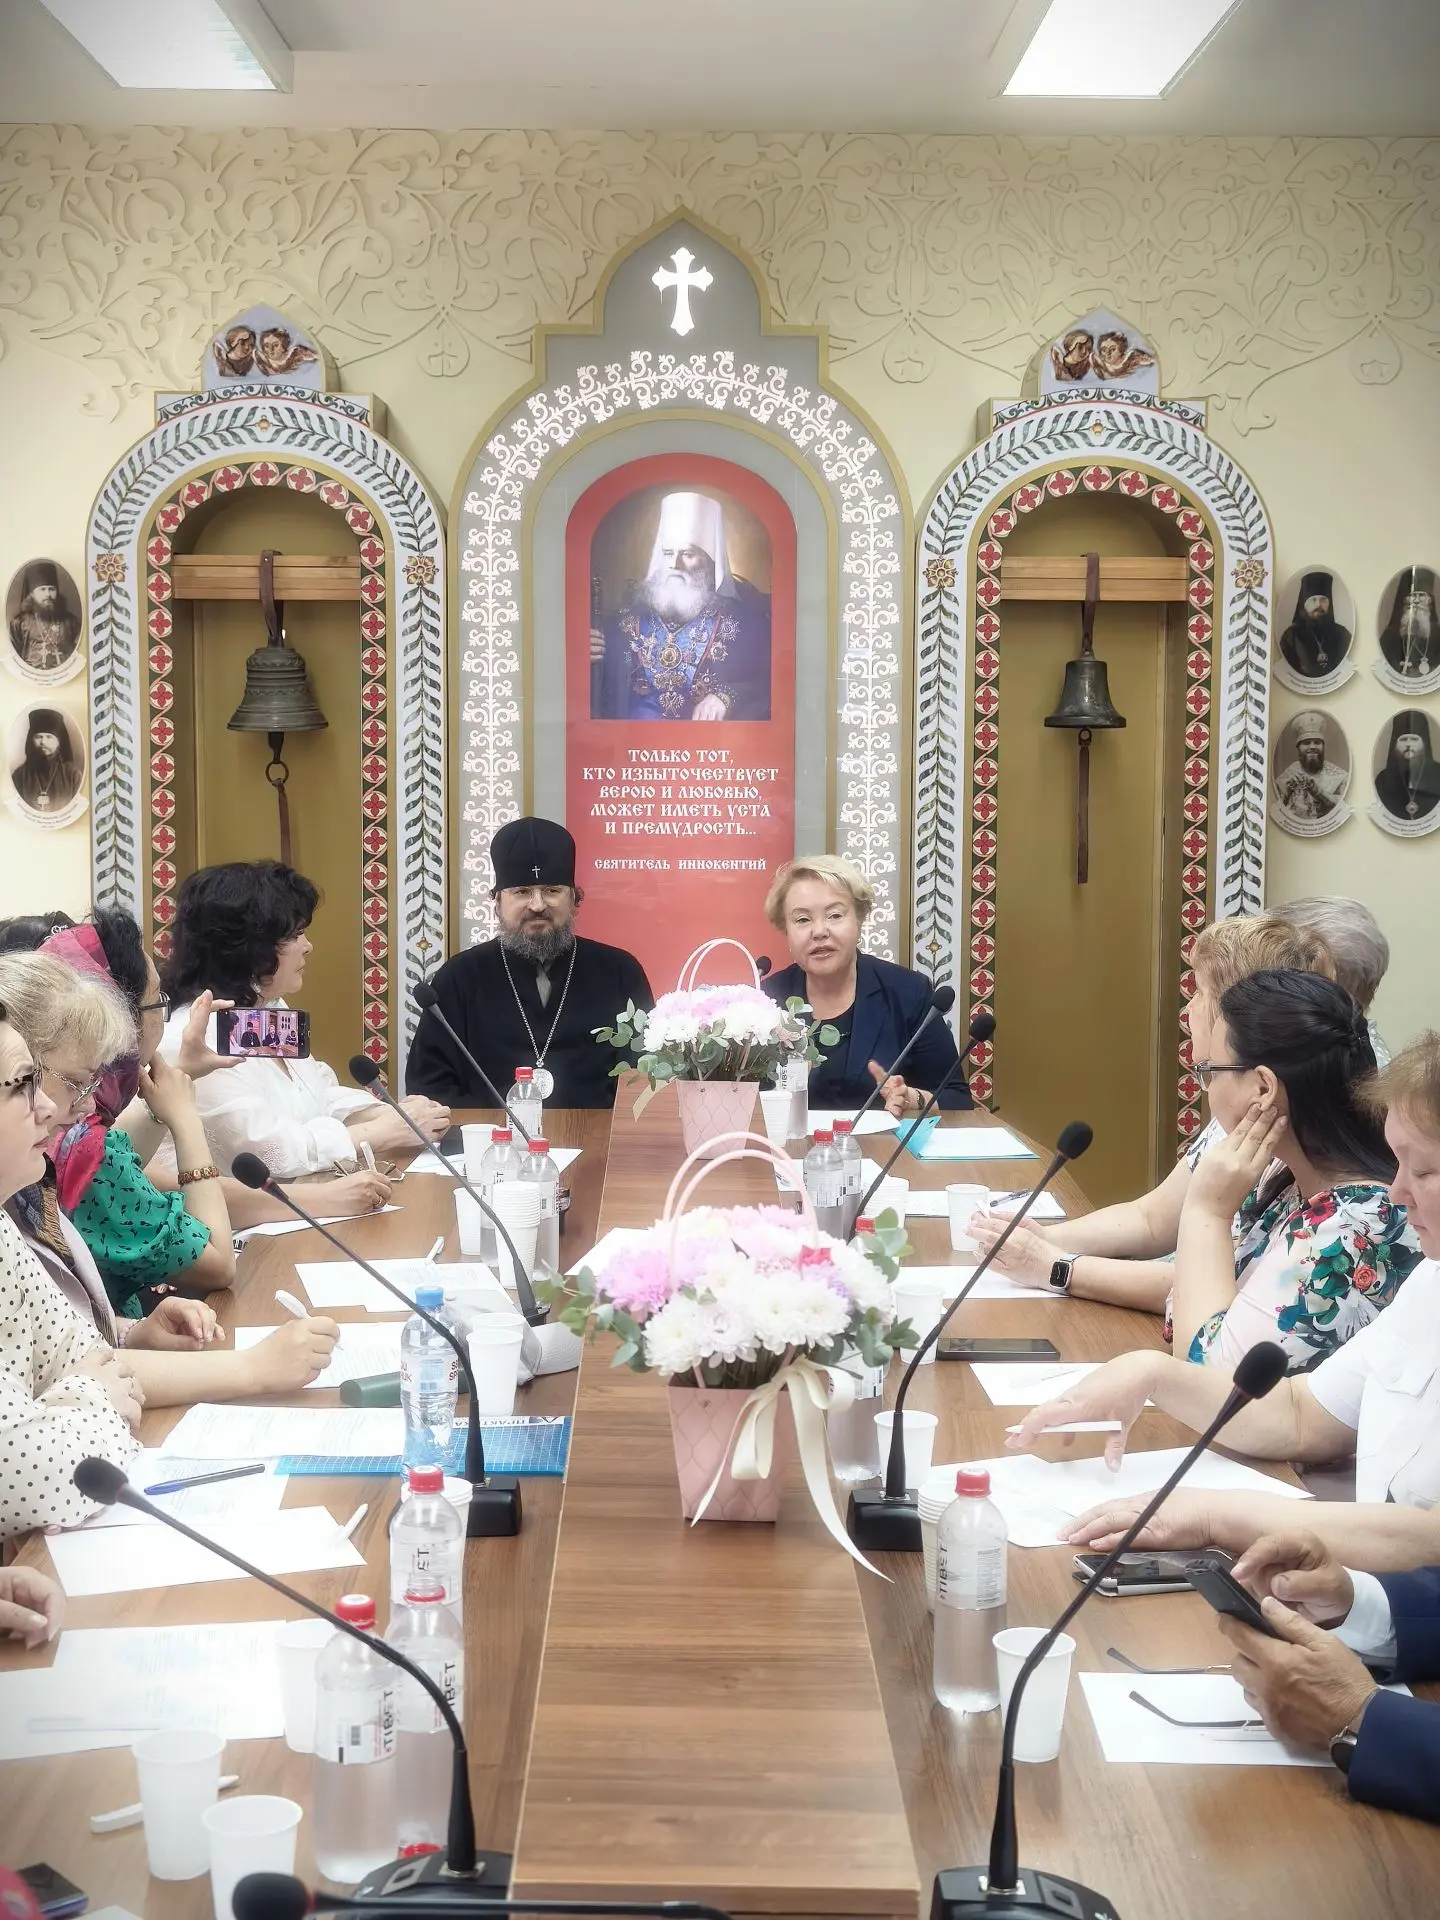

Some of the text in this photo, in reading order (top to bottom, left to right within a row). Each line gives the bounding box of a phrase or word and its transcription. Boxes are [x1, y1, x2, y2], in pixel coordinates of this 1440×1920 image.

[628, 749, 735, 766] ТОЛЬКО ТОТ,
[582, 767, 779, 785] КТО ИЗБЫТОЧЕСТВУЕТ
[599, 785, 763, 801] ВЕРОЮ И ЛЮБОВЬЮ,
[590, 803, 771, 820] МОЖЕТ ИМЕТЬ УСТА
[604, 821, 757, 838] И ПРЕМУДРОСТЬ...
[594, 857, 767, 870] СВЯТИТЕЛЬ ИННОКЕНТИЙ
[455, 1419, 525, 1427] ПРАКТКА
[444, 1662, 456, 1716] IBET
[383, 1689, 394, 1748] TIBET
